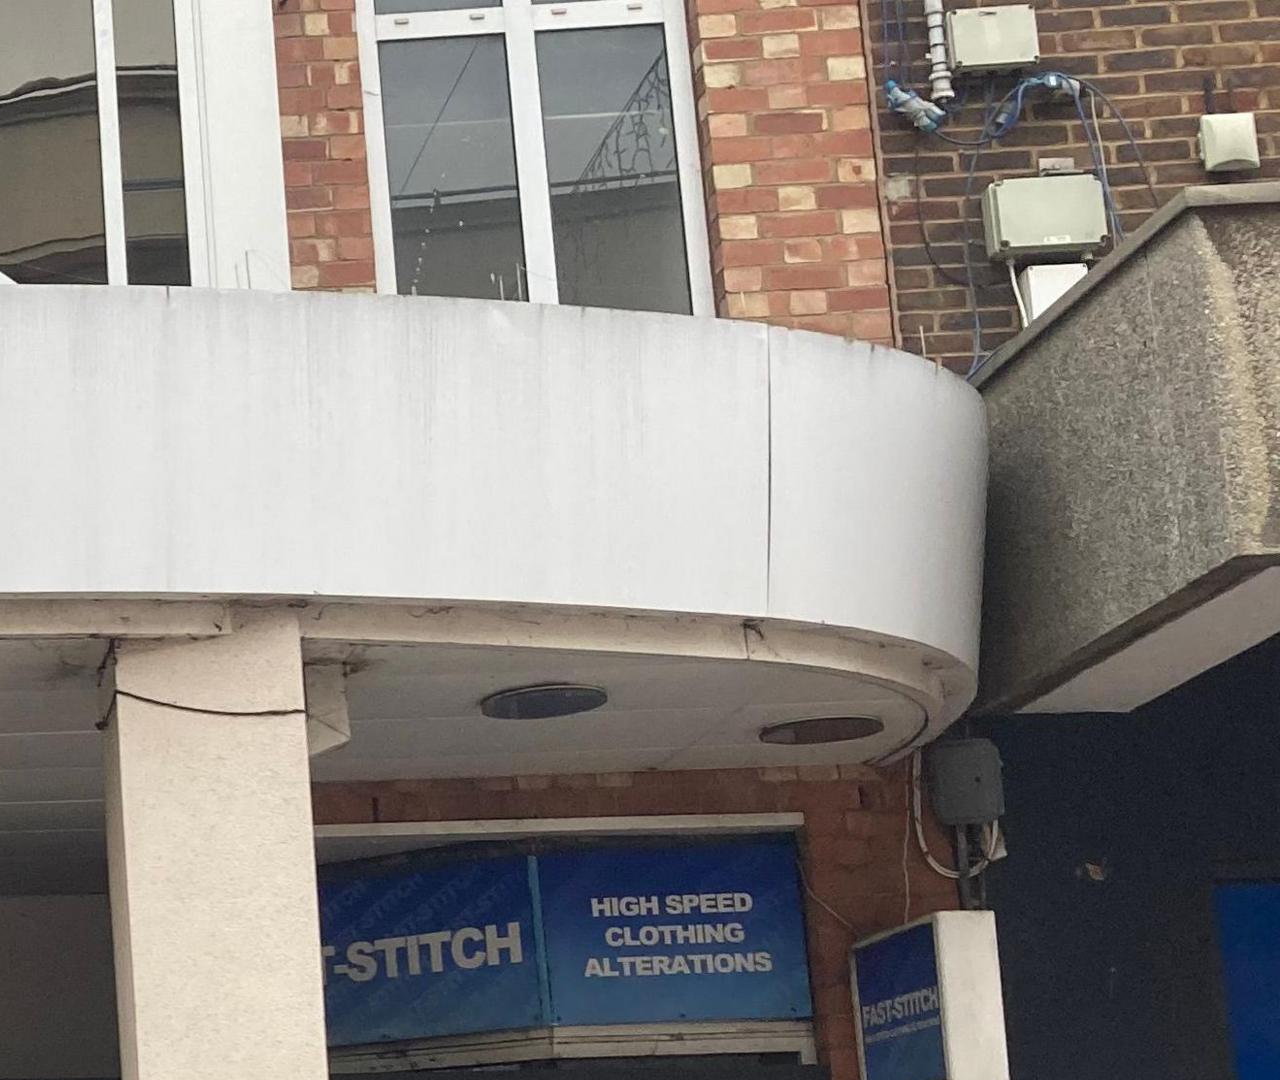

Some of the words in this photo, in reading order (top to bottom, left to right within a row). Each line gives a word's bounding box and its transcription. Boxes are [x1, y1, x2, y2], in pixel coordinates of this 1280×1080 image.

[591, 896, 660, 917] HIGH
[665, 892, 753, 915] SPEED
[605, 922, 745, 947] CLOTHING
[584, 952, 774, 978] ALTERATIONS
[862, 985, 939, 1028] FAST-STITCH
